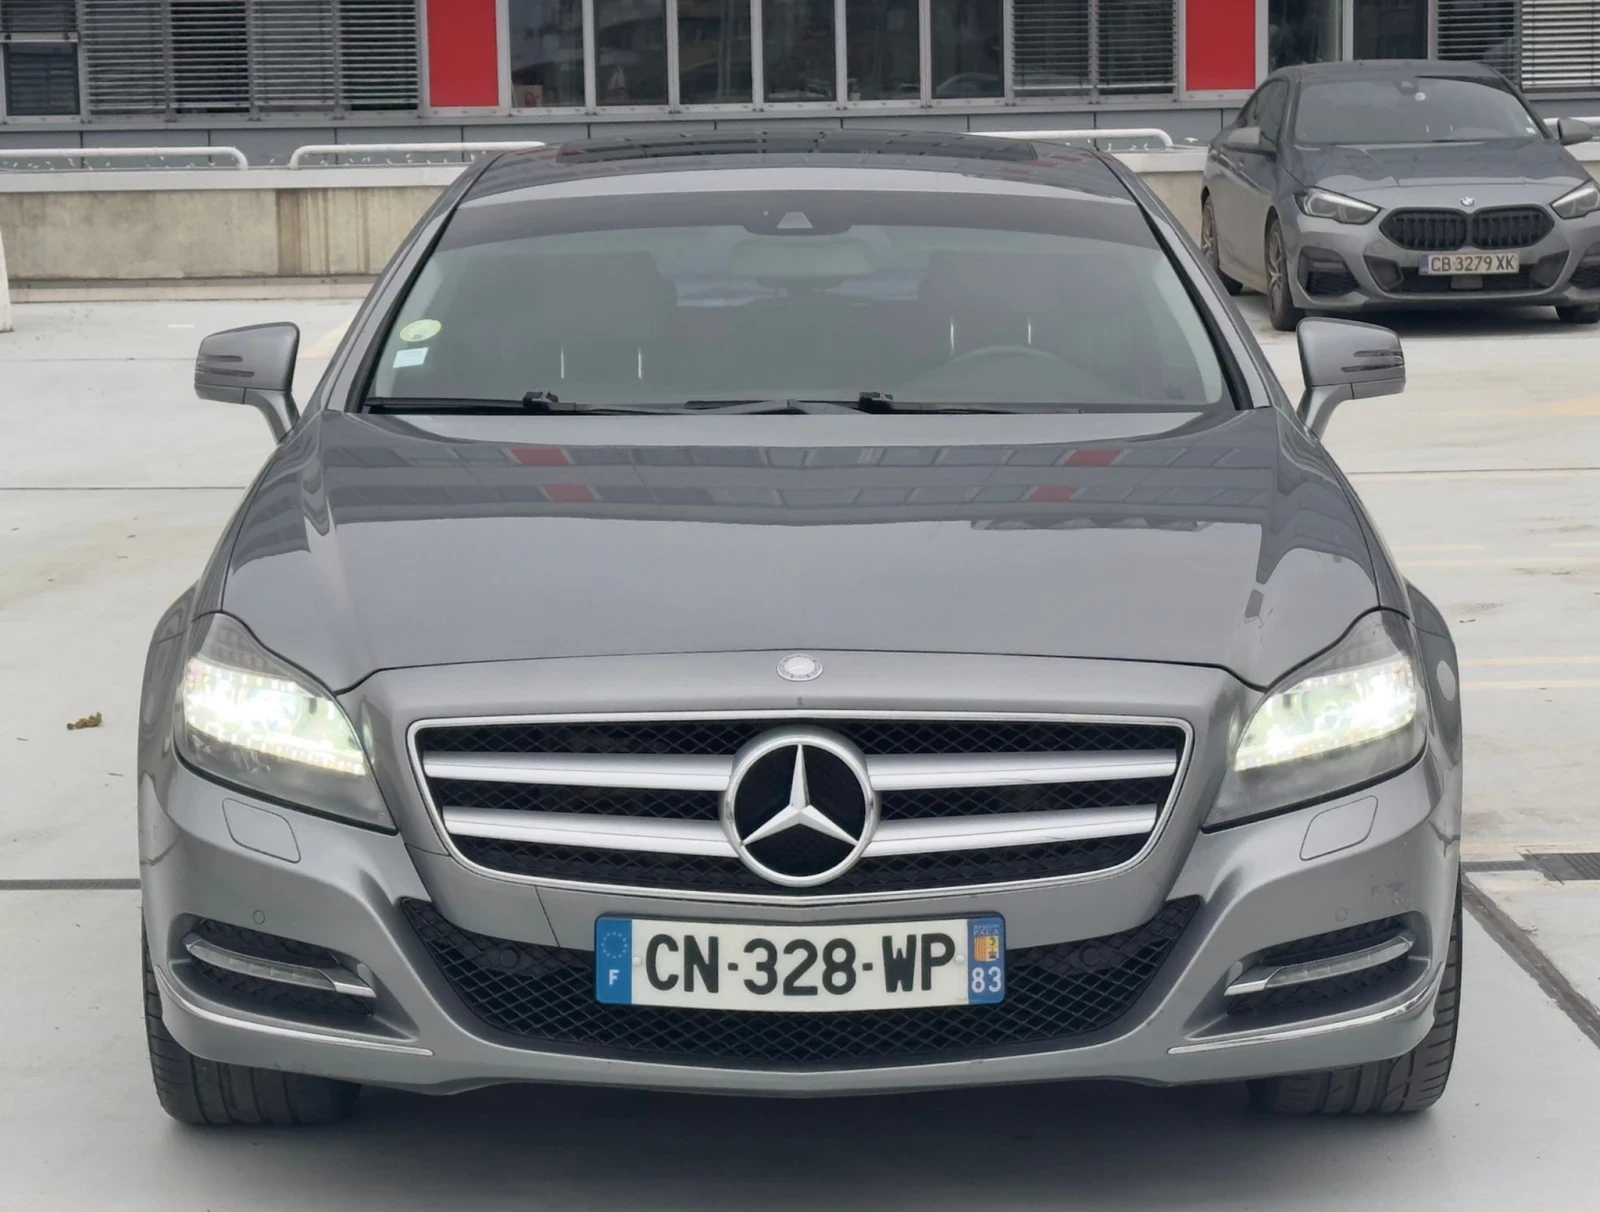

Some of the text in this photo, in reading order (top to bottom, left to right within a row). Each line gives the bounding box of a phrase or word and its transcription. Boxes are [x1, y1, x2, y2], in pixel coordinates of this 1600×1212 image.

[1431, 255, 1515, 272] CB 3279 XK
[645, 933, 956, 995] CN-328-WP
[609, 969, 620, 985] F
[971, 966, 1002, 993] 83
